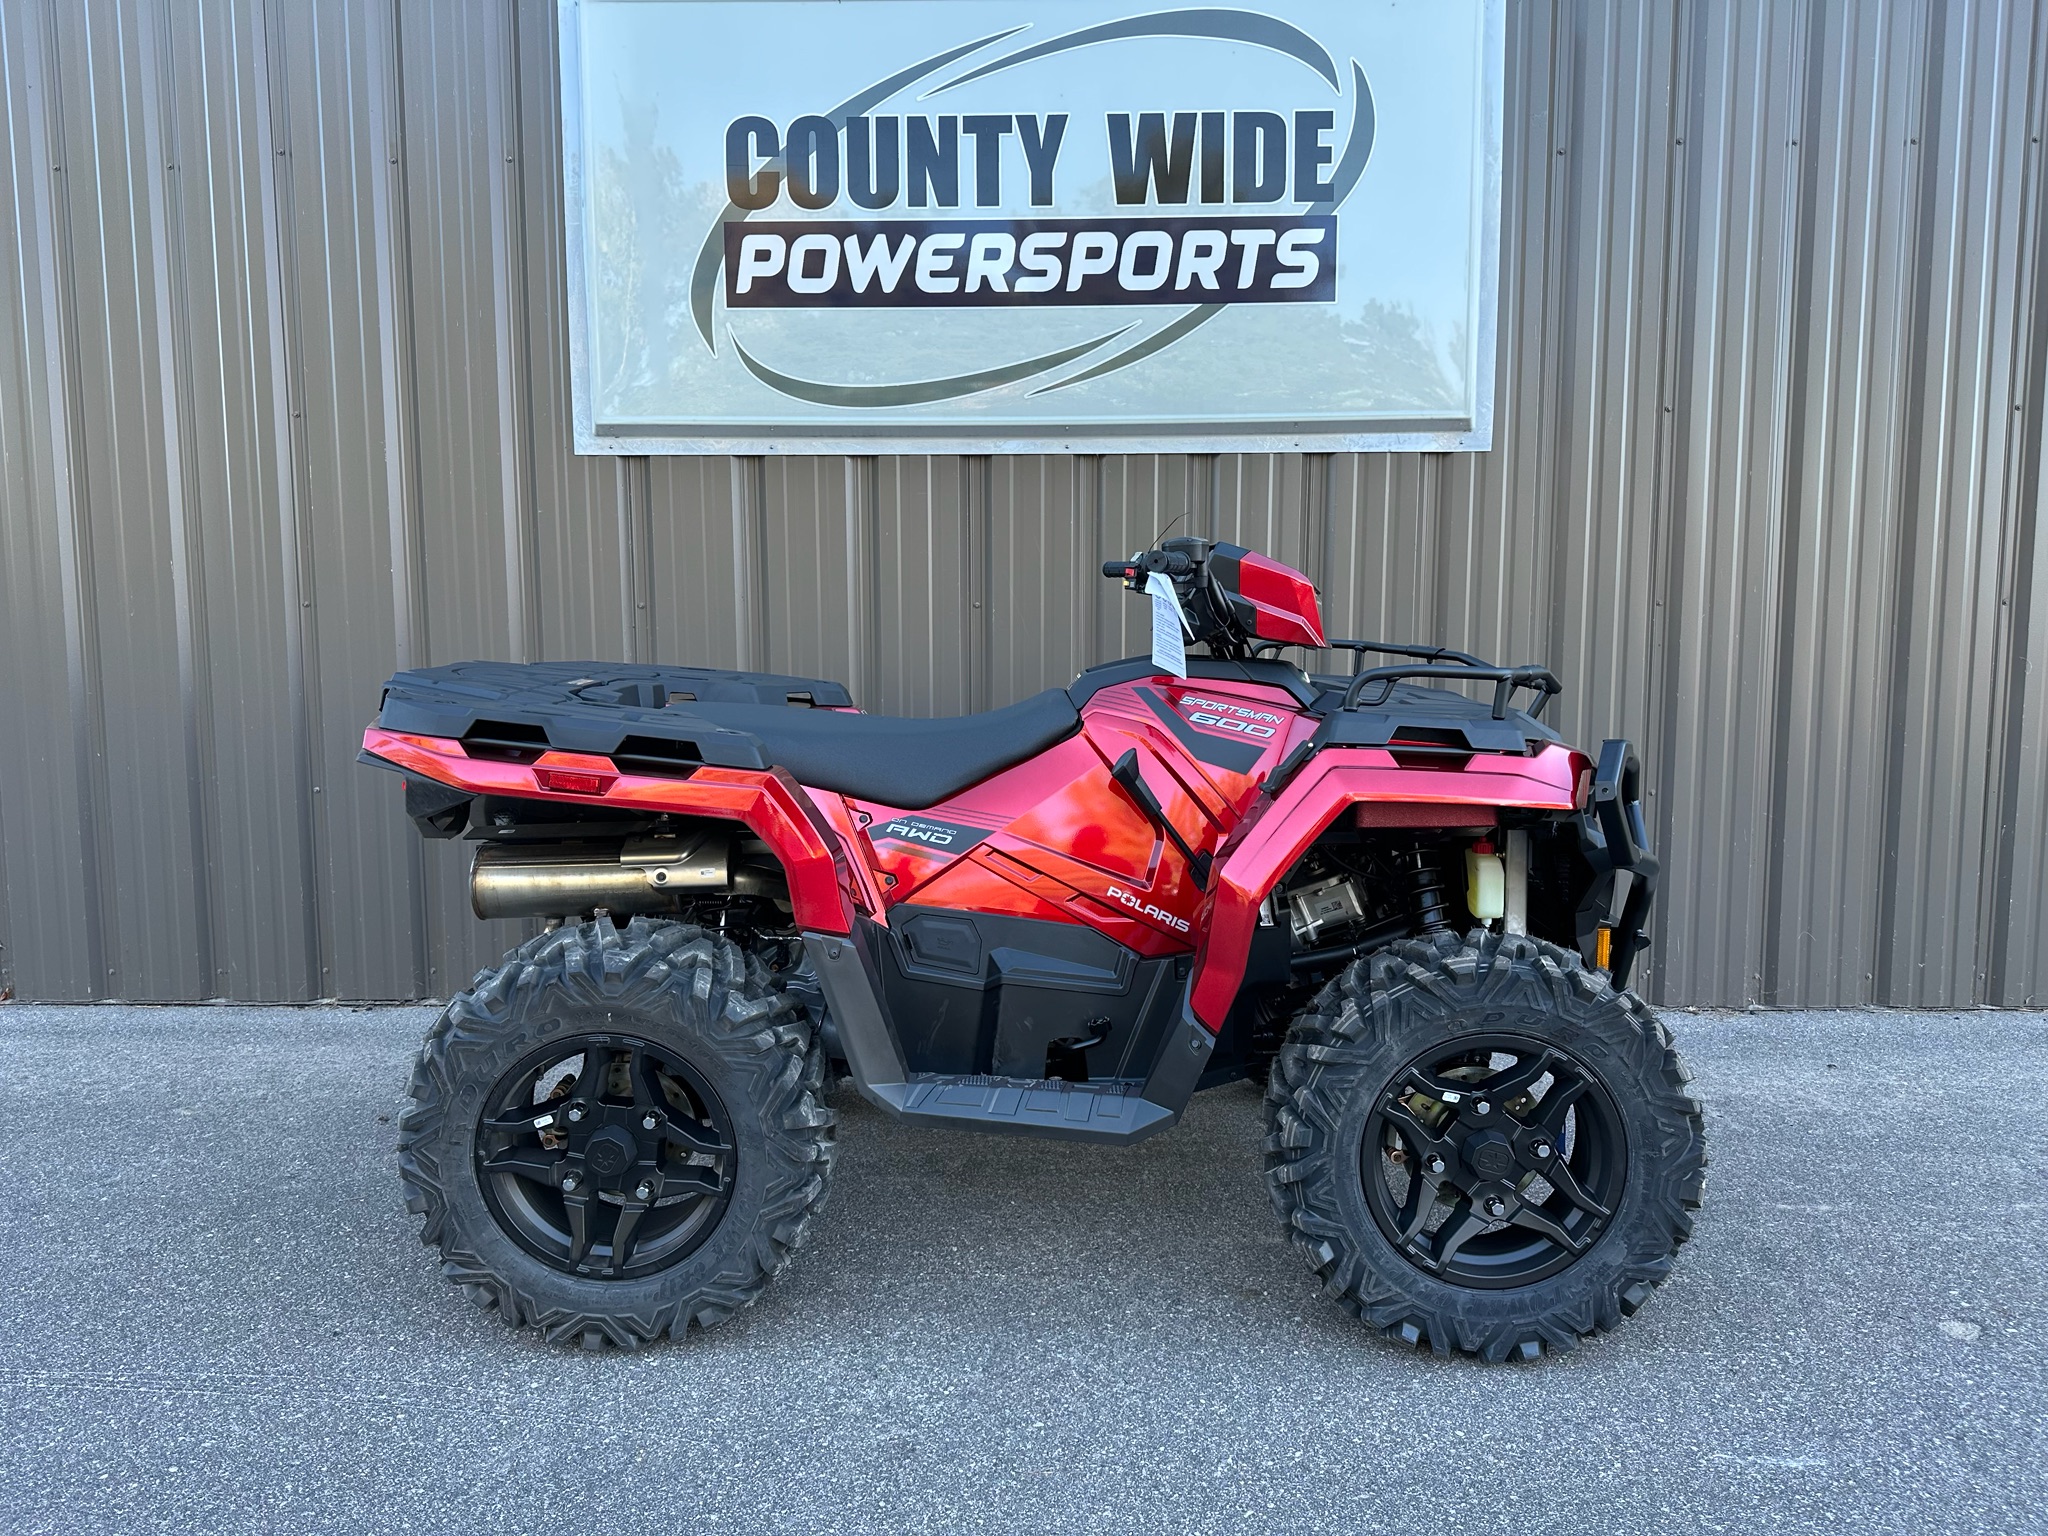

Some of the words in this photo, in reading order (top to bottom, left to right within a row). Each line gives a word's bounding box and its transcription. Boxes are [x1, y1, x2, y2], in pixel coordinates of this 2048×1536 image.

[725, 114, 1069, 210] COUNTY
[1106, 110, 1335, 205] WIDE
[735, 228, 1326, 294] POWERSPORTS
[1179, 695, 1285, 725] SPORTSMAN
[1188, 711, 1277, 739] 600
[885, 823, 953, 845] AWD
[1106, 885, 1190, 933] POLARIS
